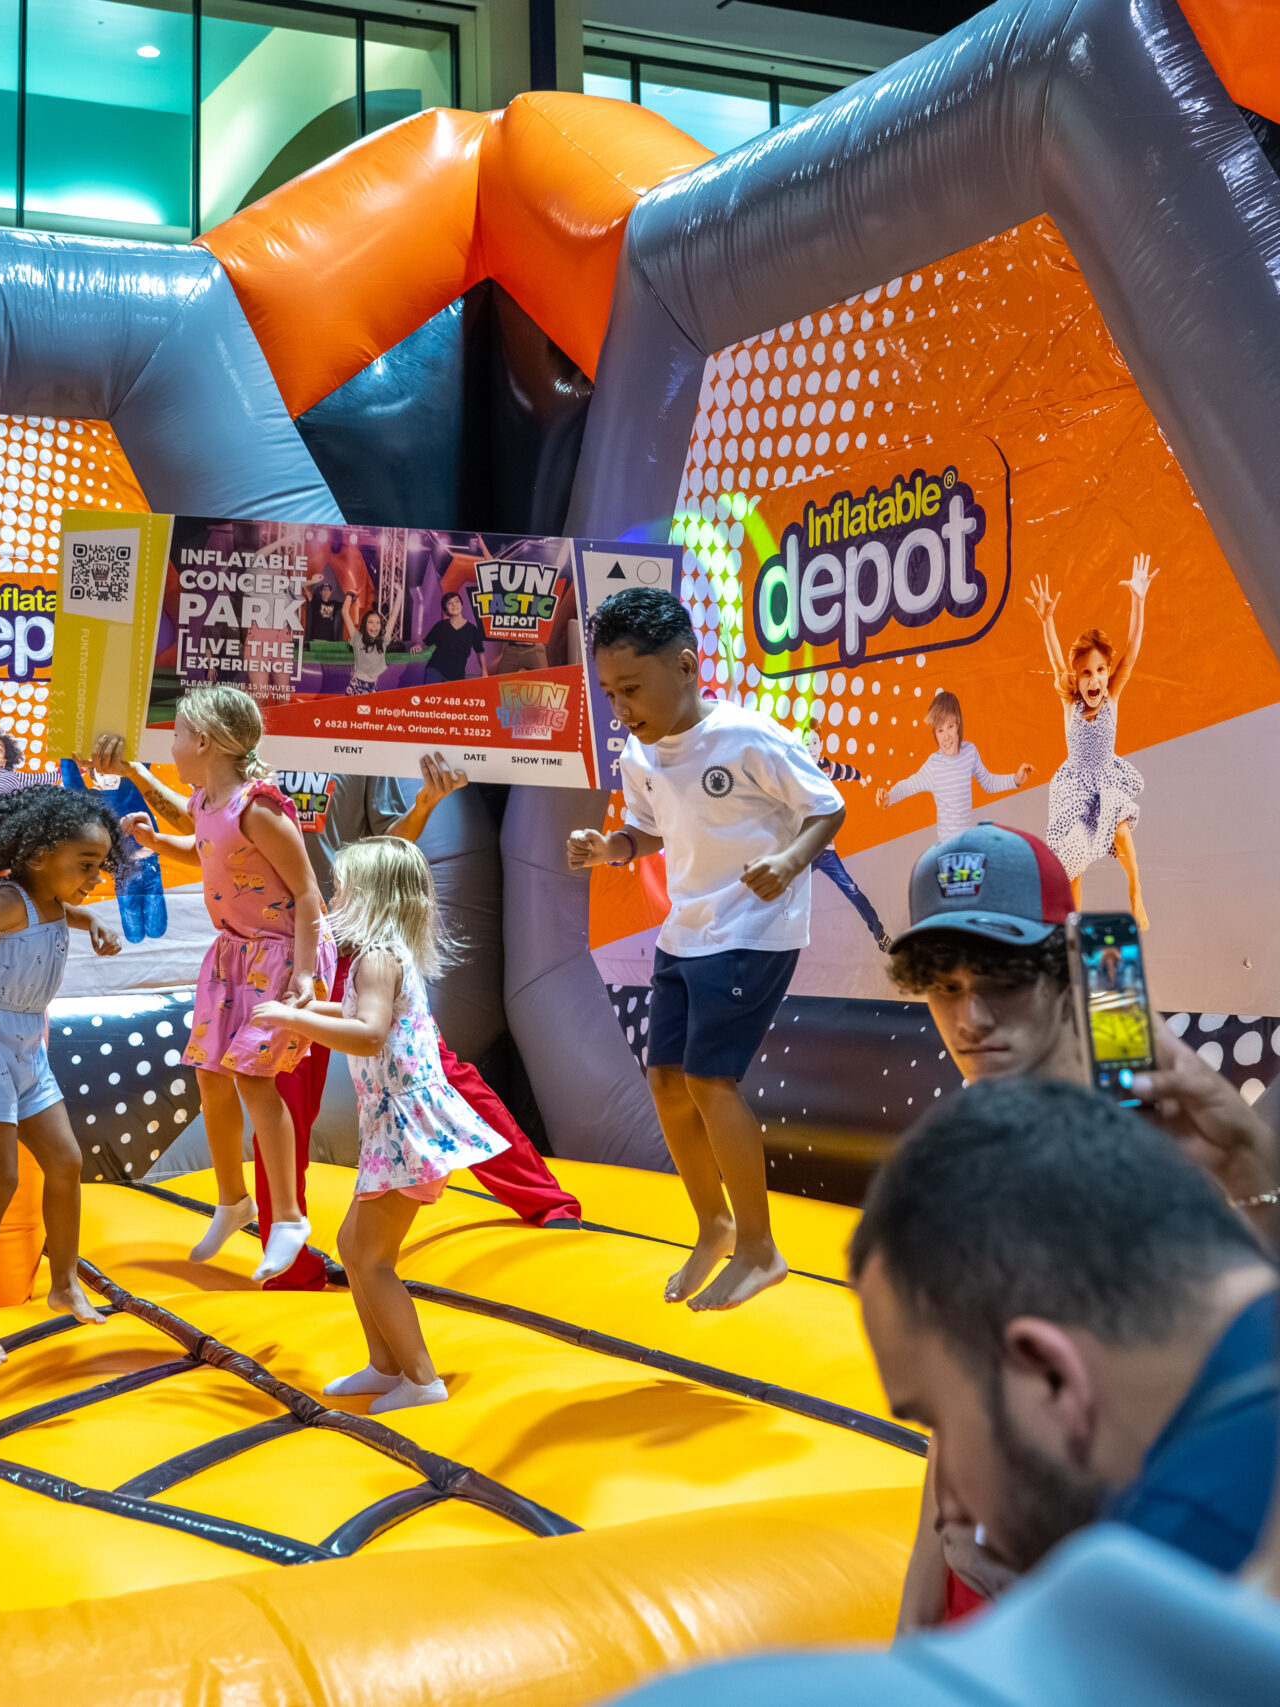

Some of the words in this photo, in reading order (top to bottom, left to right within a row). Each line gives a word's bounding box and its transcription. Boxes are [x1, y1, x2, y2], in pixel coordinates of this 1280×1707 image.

[180, 548, 308, 571] INFLATABLE
[179, 569, 307, 595] CONCEPT
[478, 563, 556, 595] FUN
[759, 495, 978, 656] depot
[178, 592, 306, 631] PARK
[476, 592, 554, 617] TASTIC
[494, 615, 535, 627] DEPOT
[186, 636, 240, 656] LIVE
[247, 640, 295, 659] THE
[186, 656, 294, 674] EXPERIENCE
[248, 682, 258, 690] 15
[260, 684, 296, 693] MINUTES
[271, 693, 291, 701] TIME
[424, 696, 441, 705] 407
[443, 697, 461, 706] 488
[463, 698, 486, 707] 4378
[503, 684, 565, 711] FUN
[375, 707, 489, 722] info@funtasticdepot.com
[325, 719, 348, 729] 6828
[350, 721, 384, 731] Hoffner
[386, 723, 406, 733] Ave,
[408, 724, 447, 736] Orlando,
[449, 727, 461, 736] FL
[463, 728, 492, 737] 32822
[334, 745, 363, 754] EVENT
[463, 753, 487, 762] DATE
[511, 756, 539, 764] SHOW
[541, 758, 563, 766] TIME
[290, 793, 327, 812] STIC
[941, 855, 981, 873] FUN
